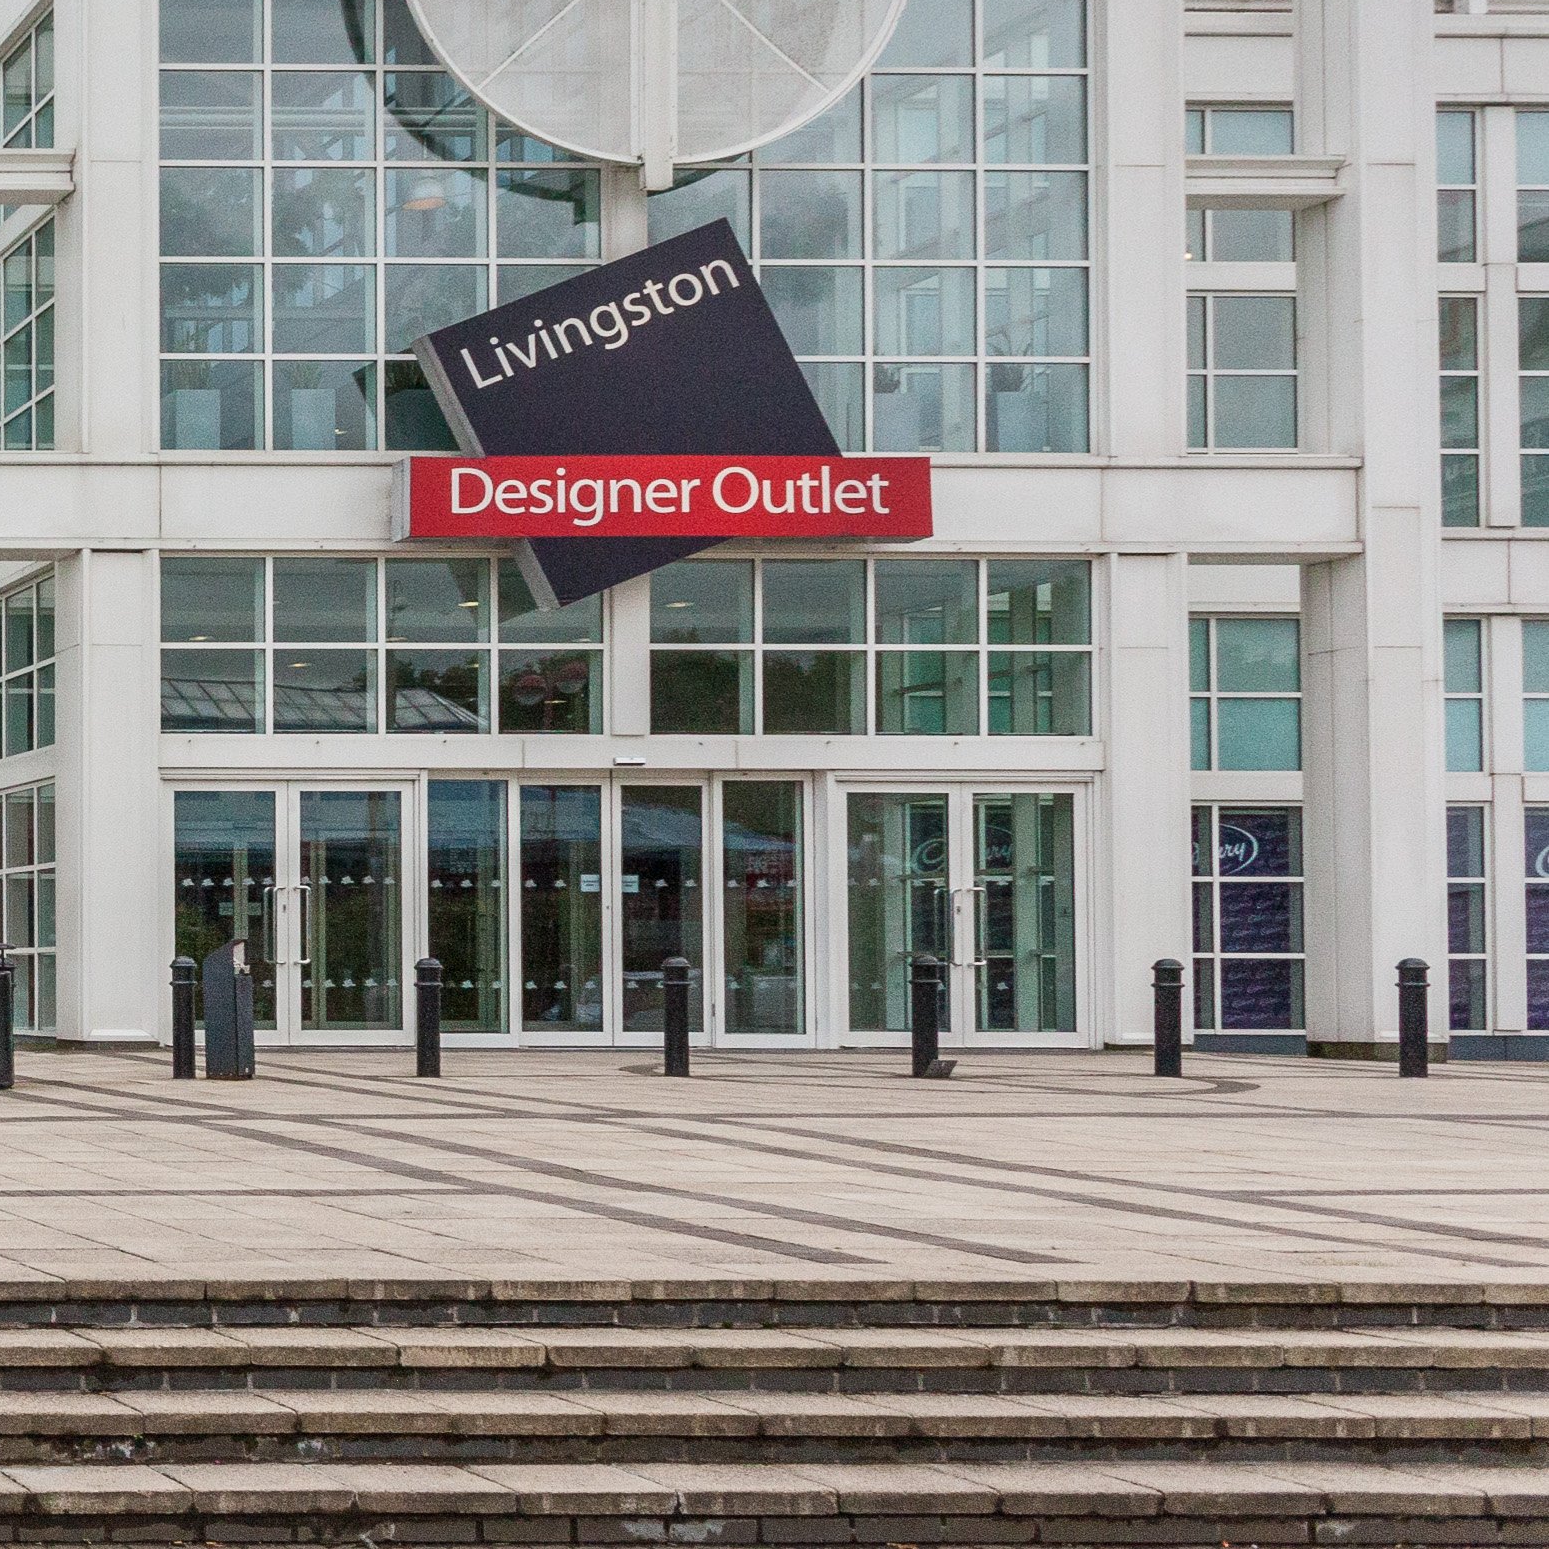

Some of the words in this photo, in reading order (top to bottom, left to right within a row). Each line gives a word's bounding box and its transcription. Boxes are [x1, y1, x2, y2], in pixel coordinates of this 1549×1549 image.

[460, 258, 740, 390] Livingston
[450, 466, 700, 527] Designer
[713, 465, 890, 515] Outlet
